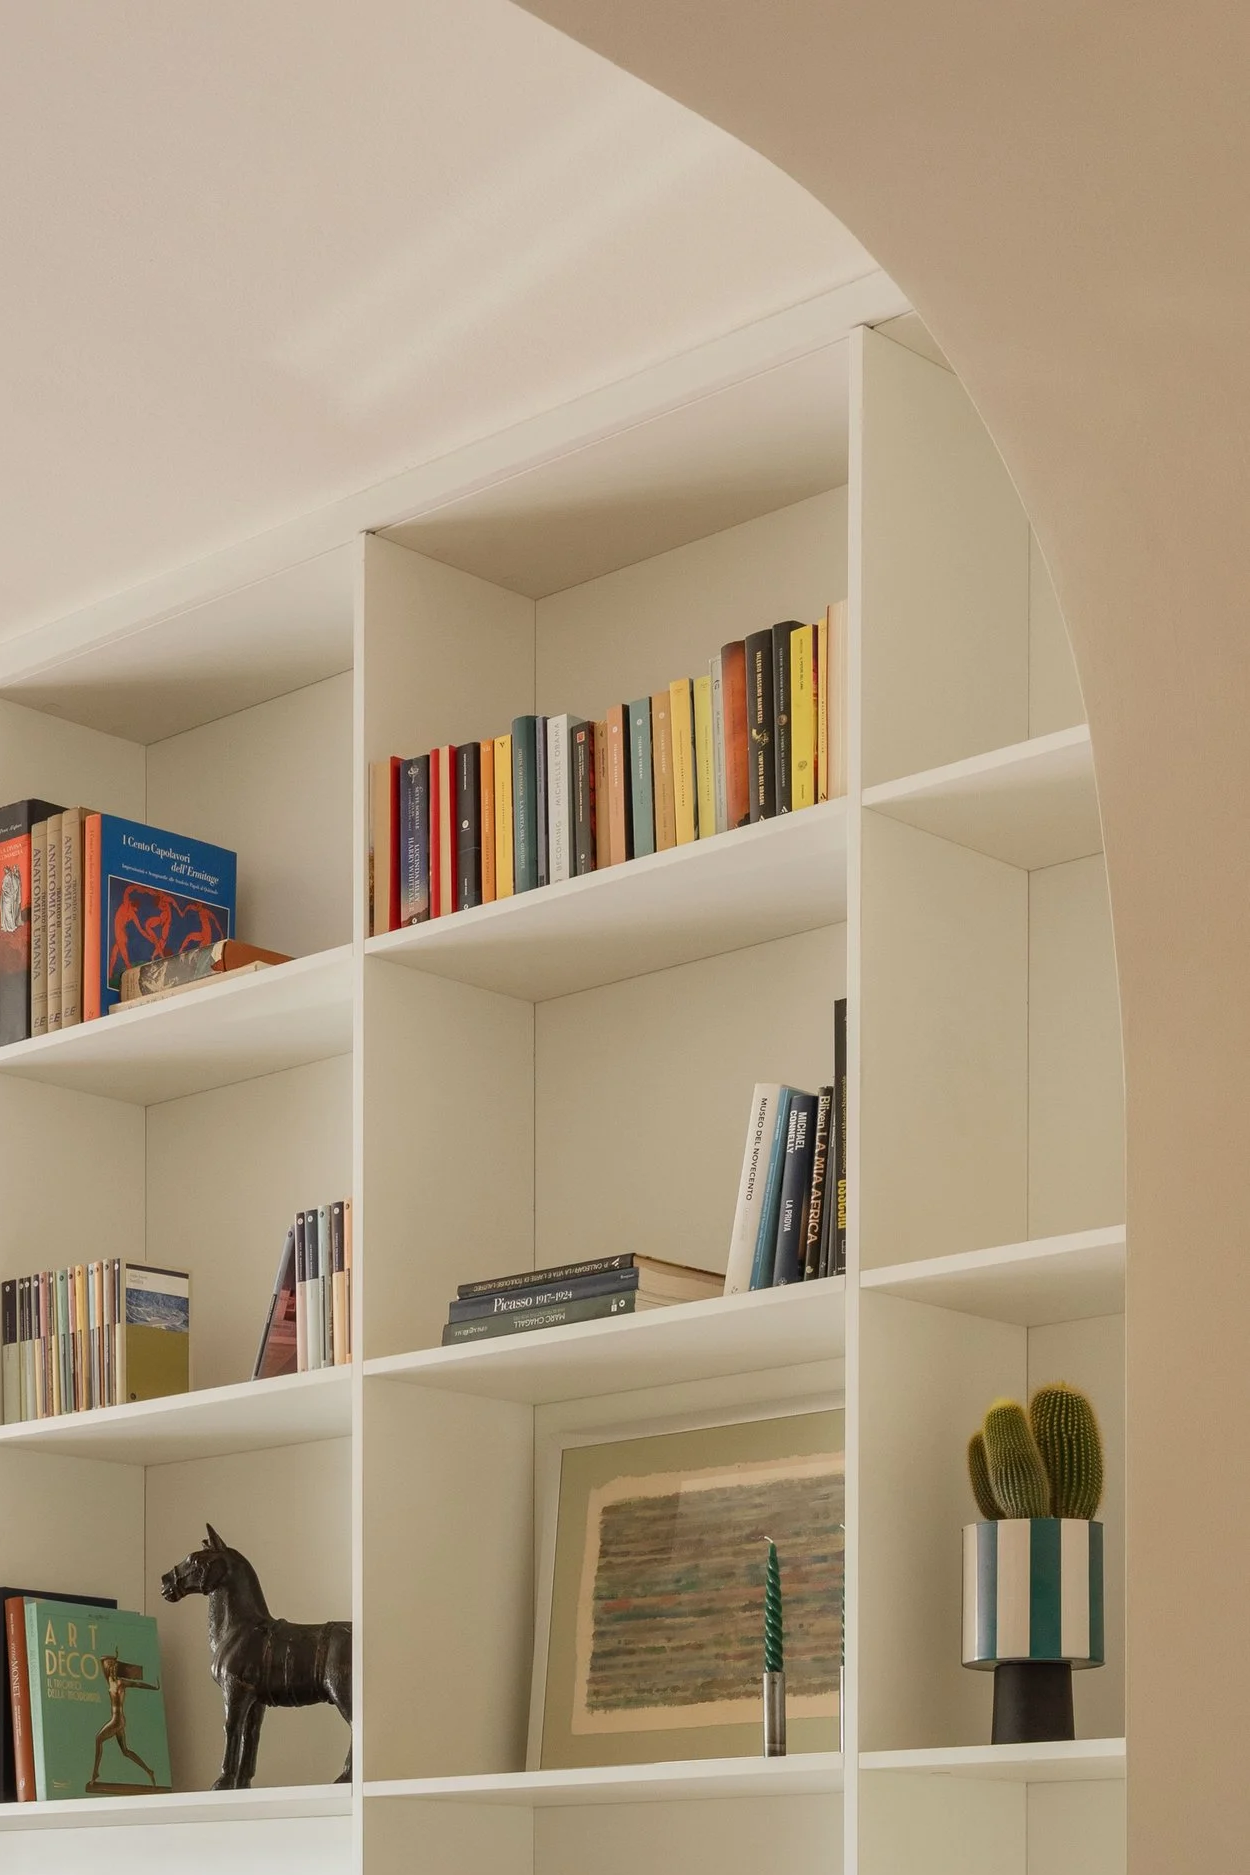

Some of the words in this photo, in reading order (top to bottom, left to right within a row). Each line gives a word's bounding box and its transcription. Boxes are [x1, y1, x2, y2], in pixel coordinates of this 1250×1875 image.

[554, 760, 562, 806] MICHELLE
[128, 836, 150, 852] Cento
[150, 843, 190, 864] Capolavori
[554, 820, 562, 872] BECOMING
[33, 848, 41, 926] ANATOMIA
[64, 835, 72, 912] ANATOMIA
[33, 928, 42, 981] UMANA
[64, 915, 72, 969] UMANA
[758, 1098, 768, 1128] MUSEO
[817, 1096, 830, 1129] Blixen
[754, 1130, 762, 1146] DEL
[786, 1110, 797, 1153] CONNELLY
[795, 1112, 807, 1150] MICHAEL
[746, 1148, 760, 1201] NOVECENTO
[811, 1156, 824, 1186] MIA
[783, 1210, 792, 1232] PROVA
[785, 1200, 793, 1208] LA
[807, 1188, 822, 1244] AFRICA
[494, 1296, 532, 1312] Picasso
[546, 1312, 566, 1323] MARC
[514, 1315, 544, 1328] CHAGALL
[45, 1620, 98, 1650] ART
[11, 1660, 20, 1698] MONET
[45, 1646, 99, 1680] DÉCO
